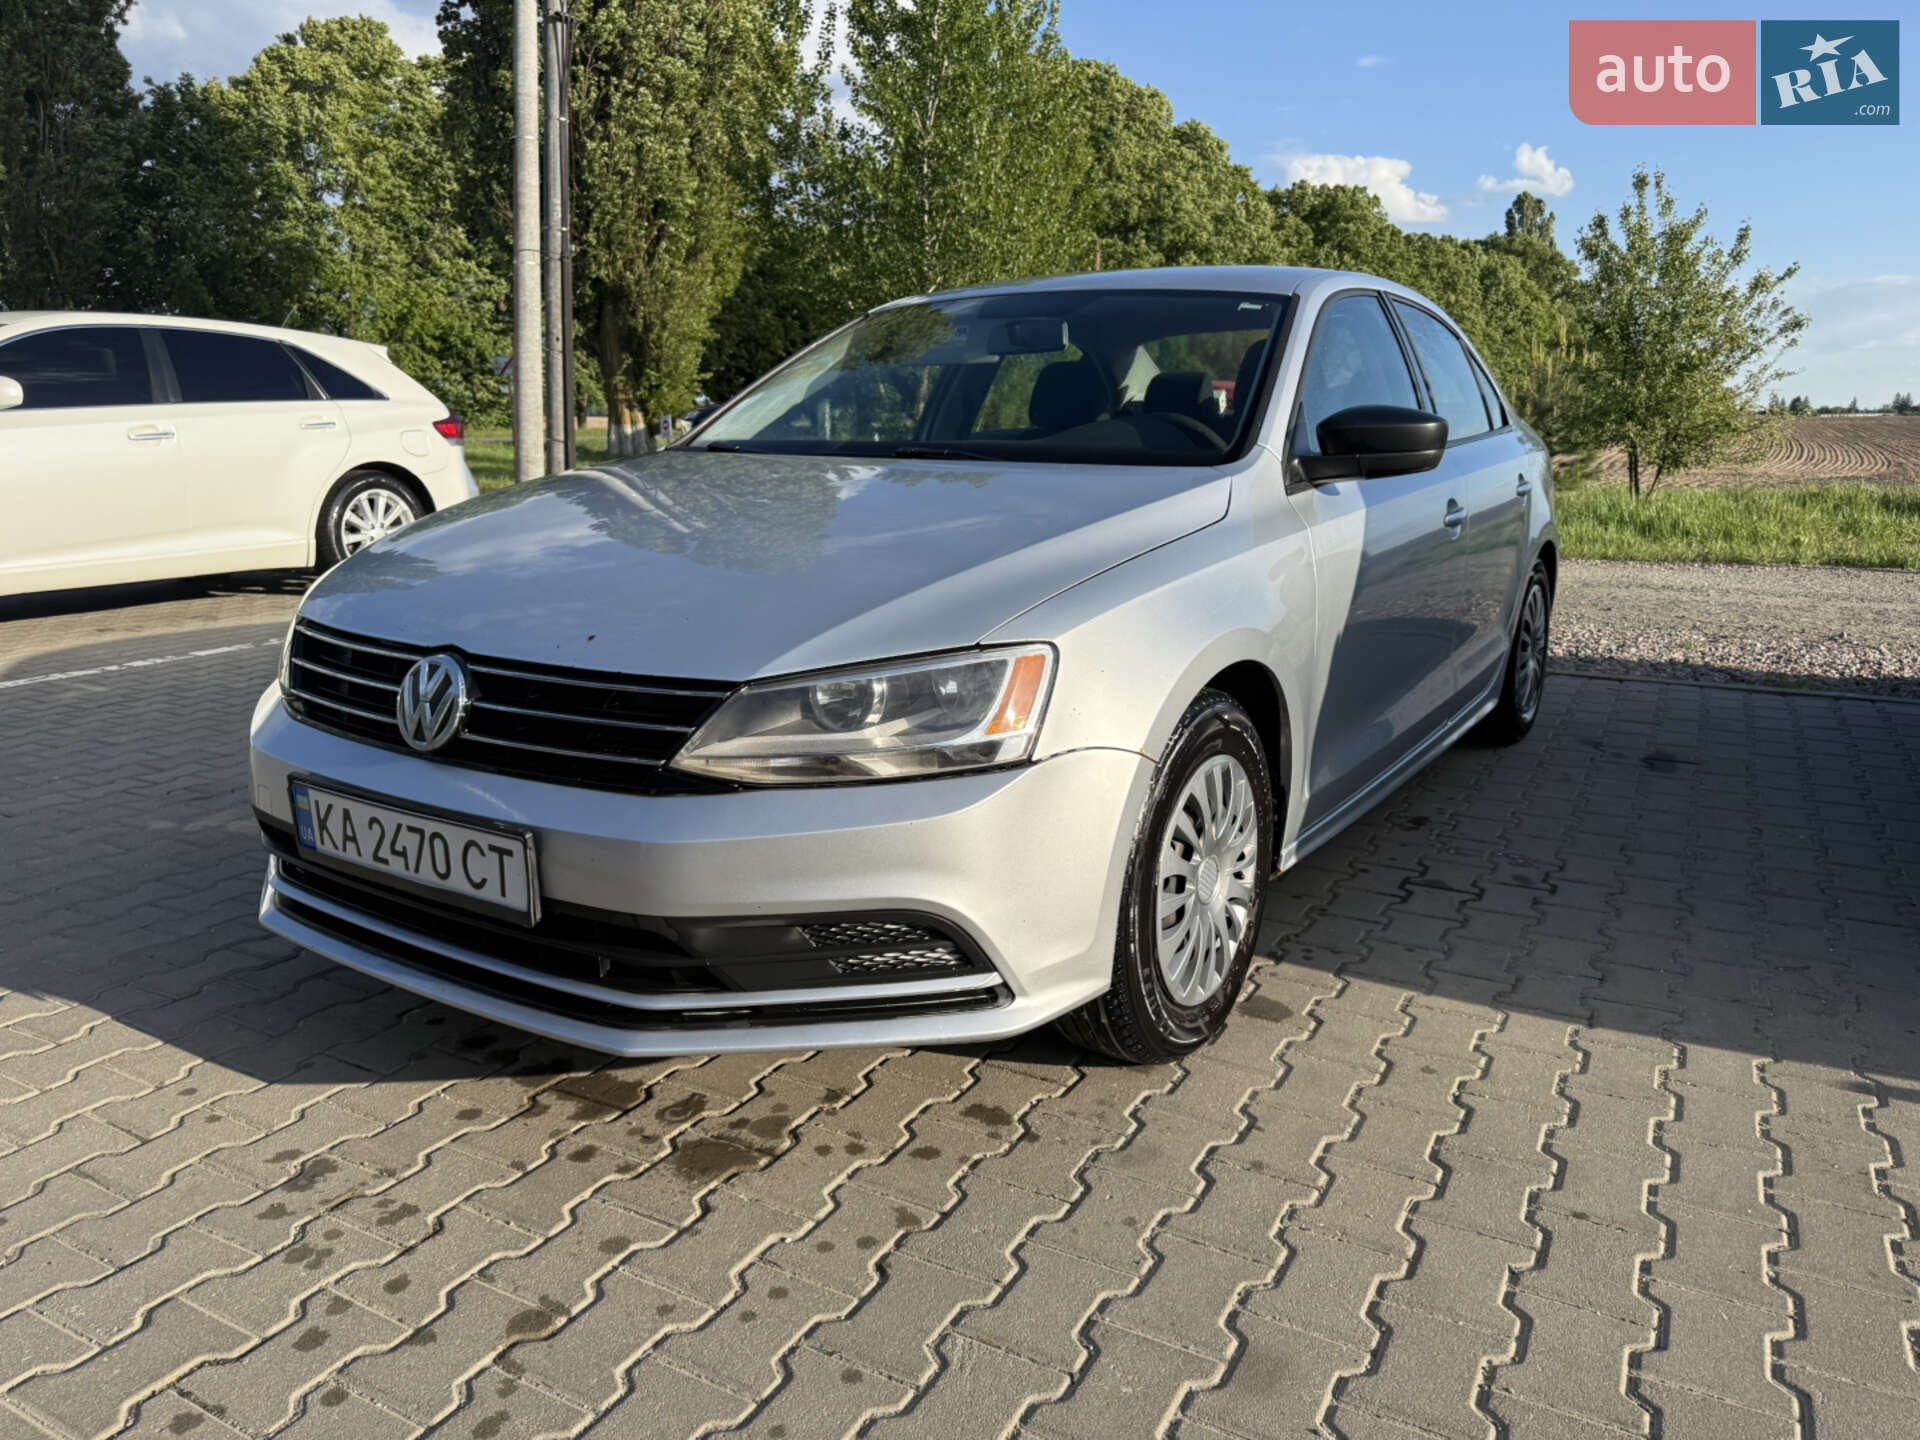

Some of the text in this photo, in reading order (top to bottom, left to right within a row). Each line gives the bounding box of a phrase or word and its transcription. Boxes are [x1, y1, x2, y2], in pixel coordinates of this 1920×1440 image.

[314, 799, 514, 898] KA 2470 CT
